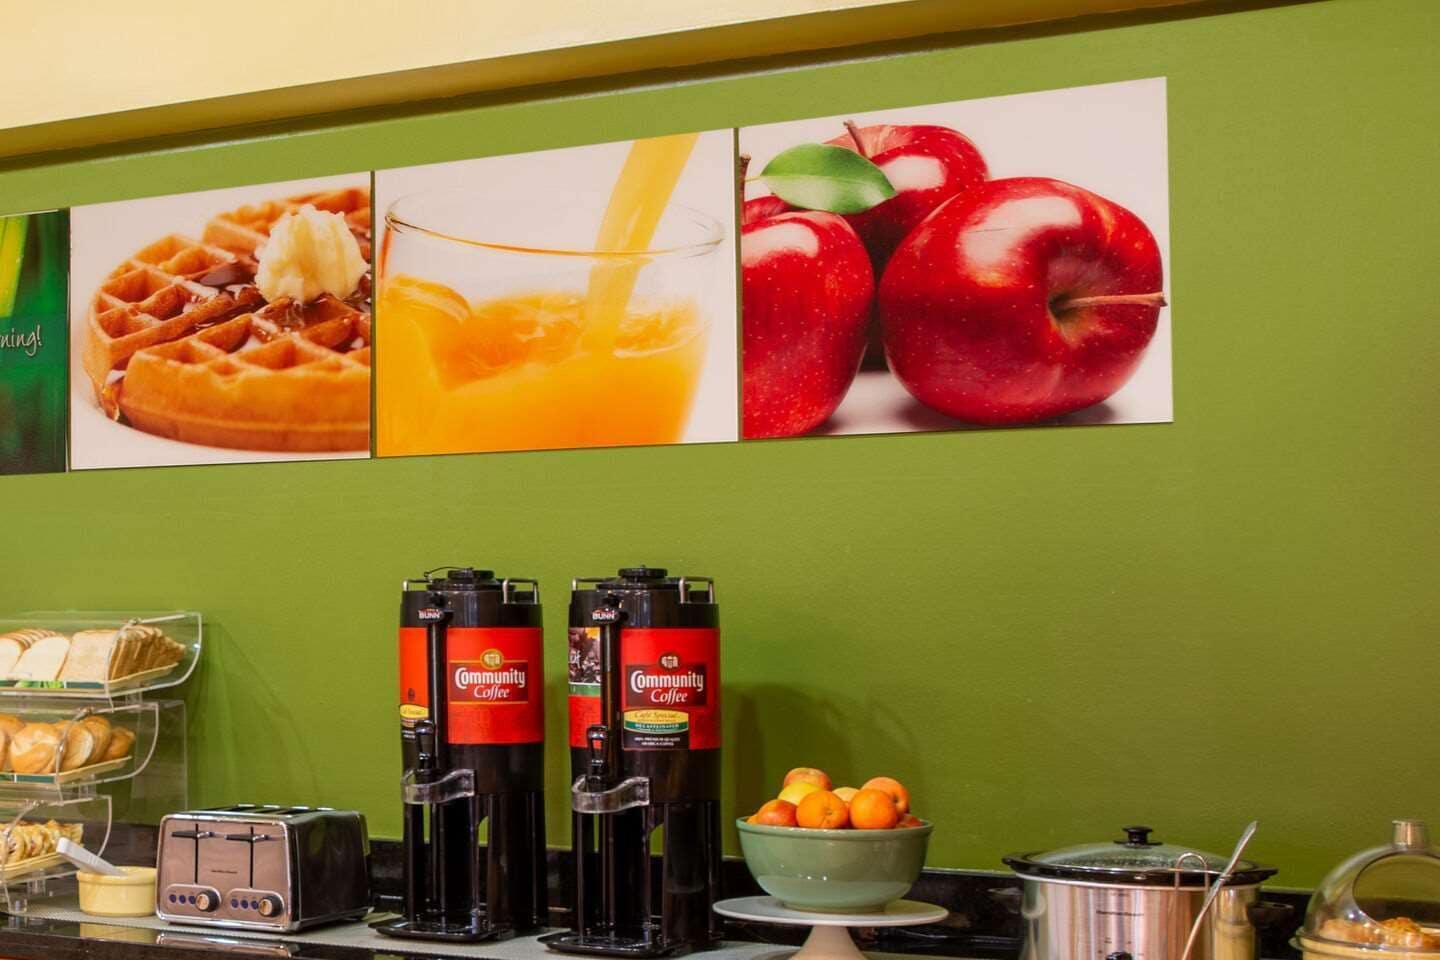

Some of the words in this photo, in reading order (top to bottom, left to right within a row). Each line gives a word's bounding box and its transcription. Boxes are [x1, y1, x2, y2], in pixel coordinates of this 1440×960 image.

[454, 667, 526, 690] Community
[630, 670, 704, 693] Community
[473, 684, 510, 701] Coffee
[650, 687, 688, 705] Coffee
